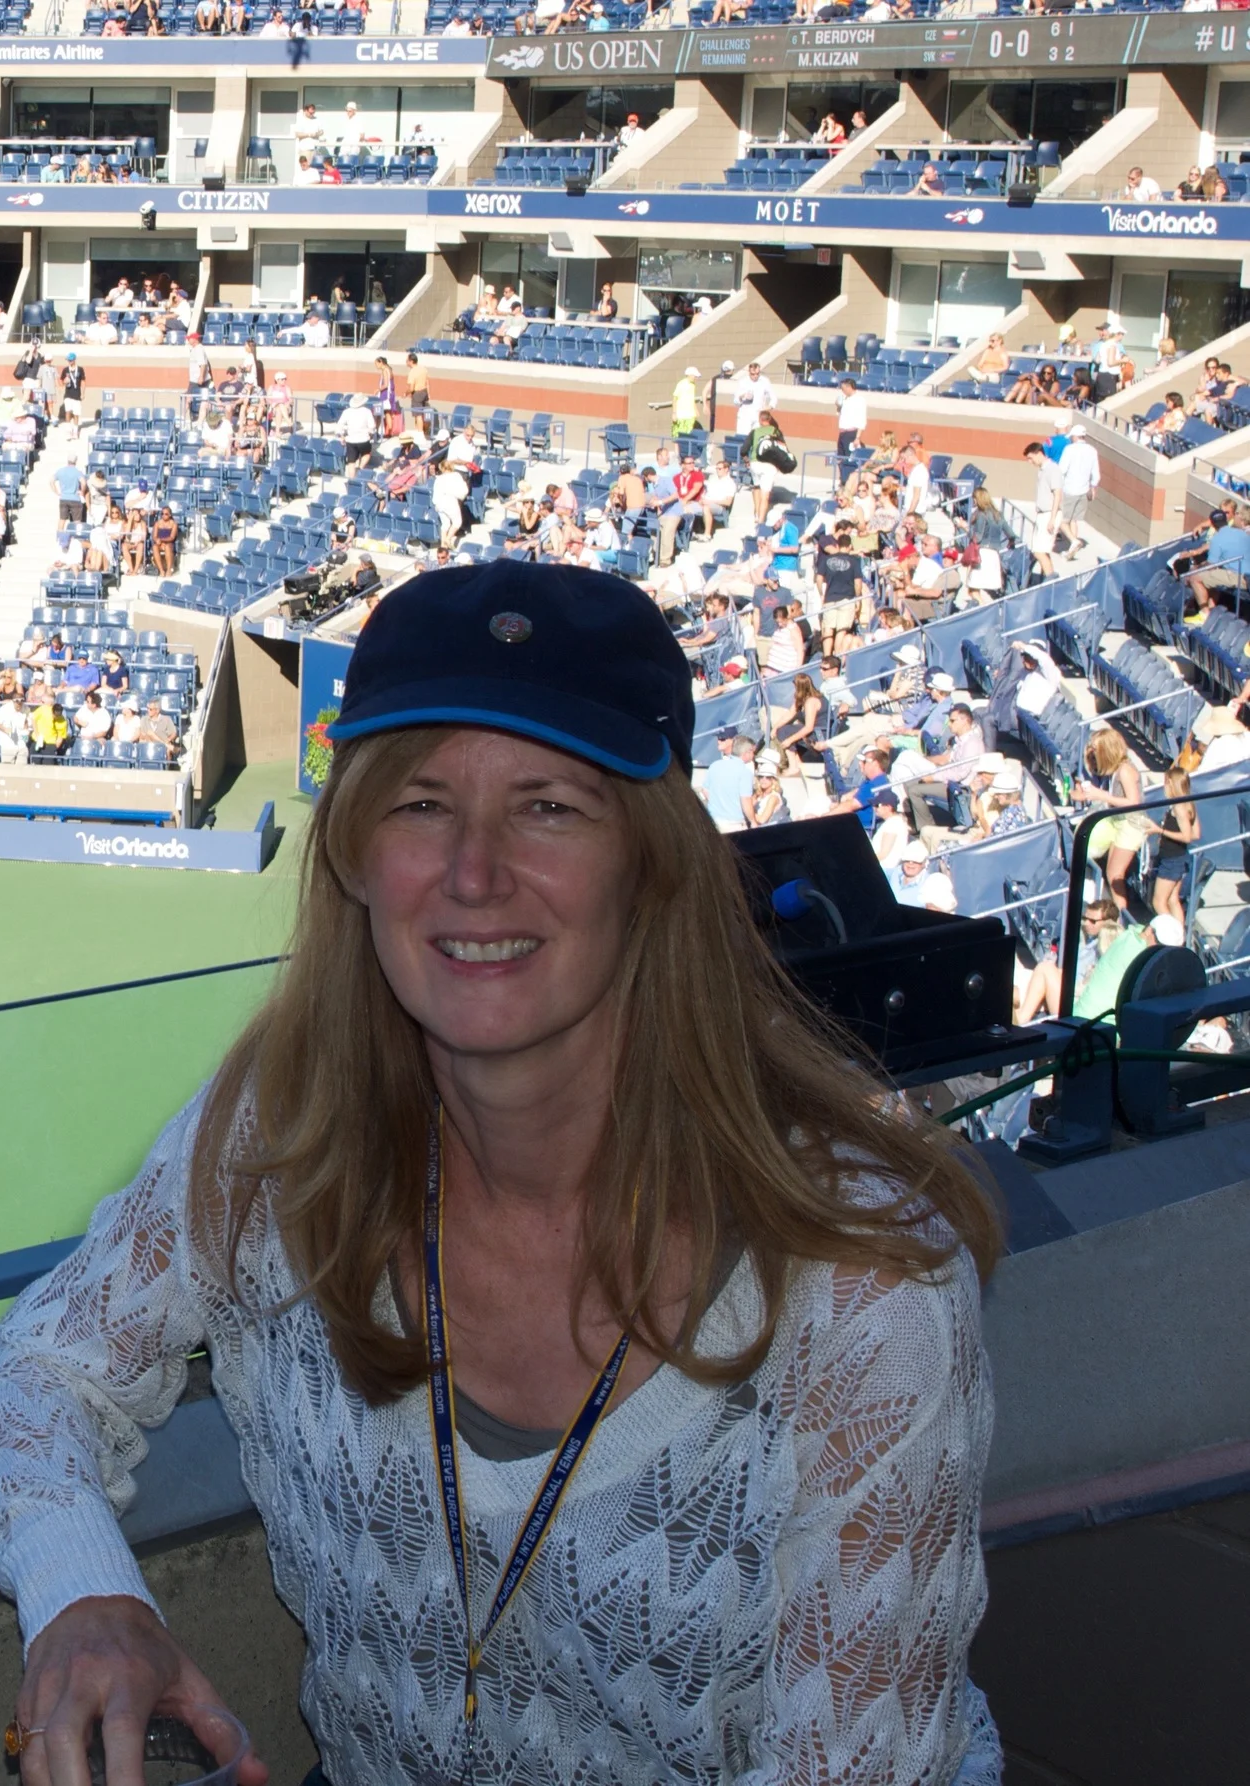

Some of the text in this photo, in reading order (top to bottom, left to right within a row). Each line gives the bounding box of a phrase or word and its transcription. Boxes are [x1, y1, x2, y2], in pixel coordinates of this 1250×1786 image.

[800, 30, 810, 45] T.
[815, 29, 875, 45] BERDYCH
[924, 30, 937, 42] CZE
[1051, 22, 1060, 37] 6
[54, 44, 104, 60] Airline
[356, 42, 440, 62] CHASE
[700, 38, 750, 52] CHALLENGES
[989, 30, 1029, 58] 0-0
[1049, 46, 1075, 61] 3 2
[554, 39, 664, 71] US OPEN
[702, 53, 747, 66] REMAINING
[923, 51, 936, 63] SVK
[177, 191, 270, 211] CITIZEN
[465, 193, 522, 215] xerox
[756, 199, 820, 222] MOËT
[440, 1444, 454, 1483] STEVE
[446, 1486, 461, 1545] FURGAL'S
[498, 1556, 525, 1606] FURGAL'S
[518, 1478, 563, 1557] INTERNATIONAL
[556, 1437, 582, 1475] TENNIS
